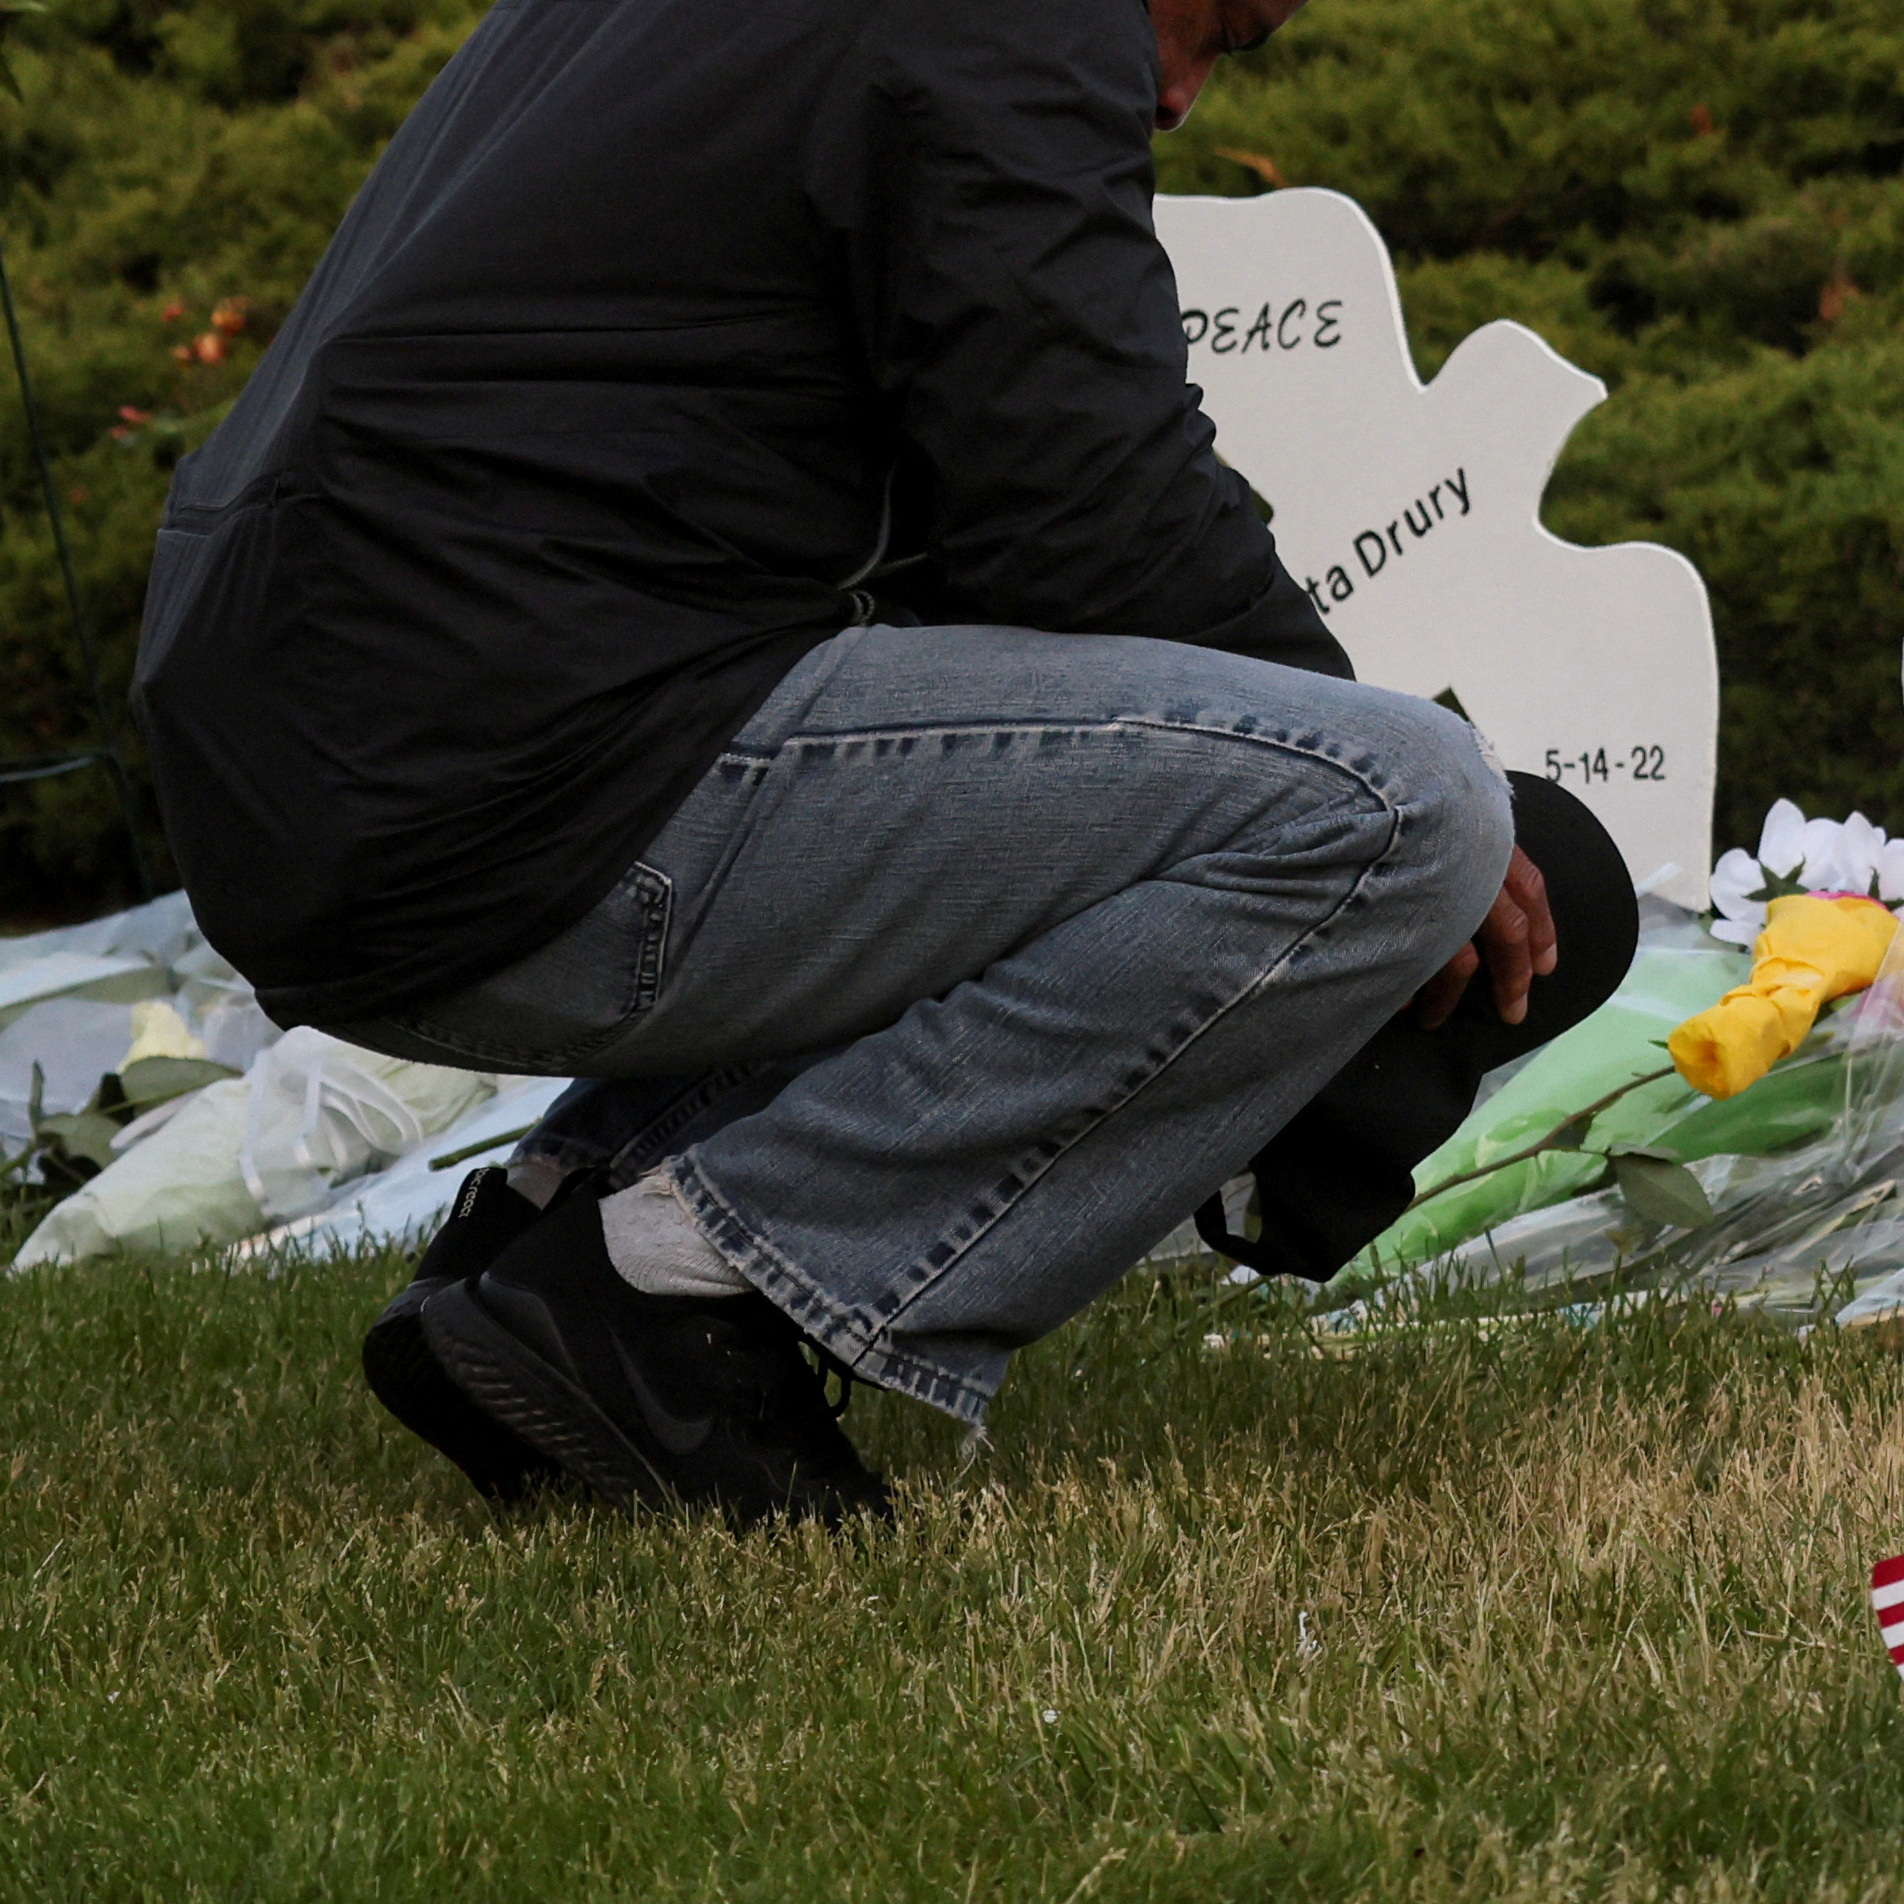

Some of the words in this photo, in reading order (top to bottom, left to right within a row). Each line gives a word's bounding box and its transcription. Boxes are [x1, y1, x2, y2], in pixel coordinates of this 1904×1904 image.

[1182, 298, 1344, 355] PEACE
[1353, 467, 1471, 579] Drury
[1544, 744, 1666, 784] 5-14-22
